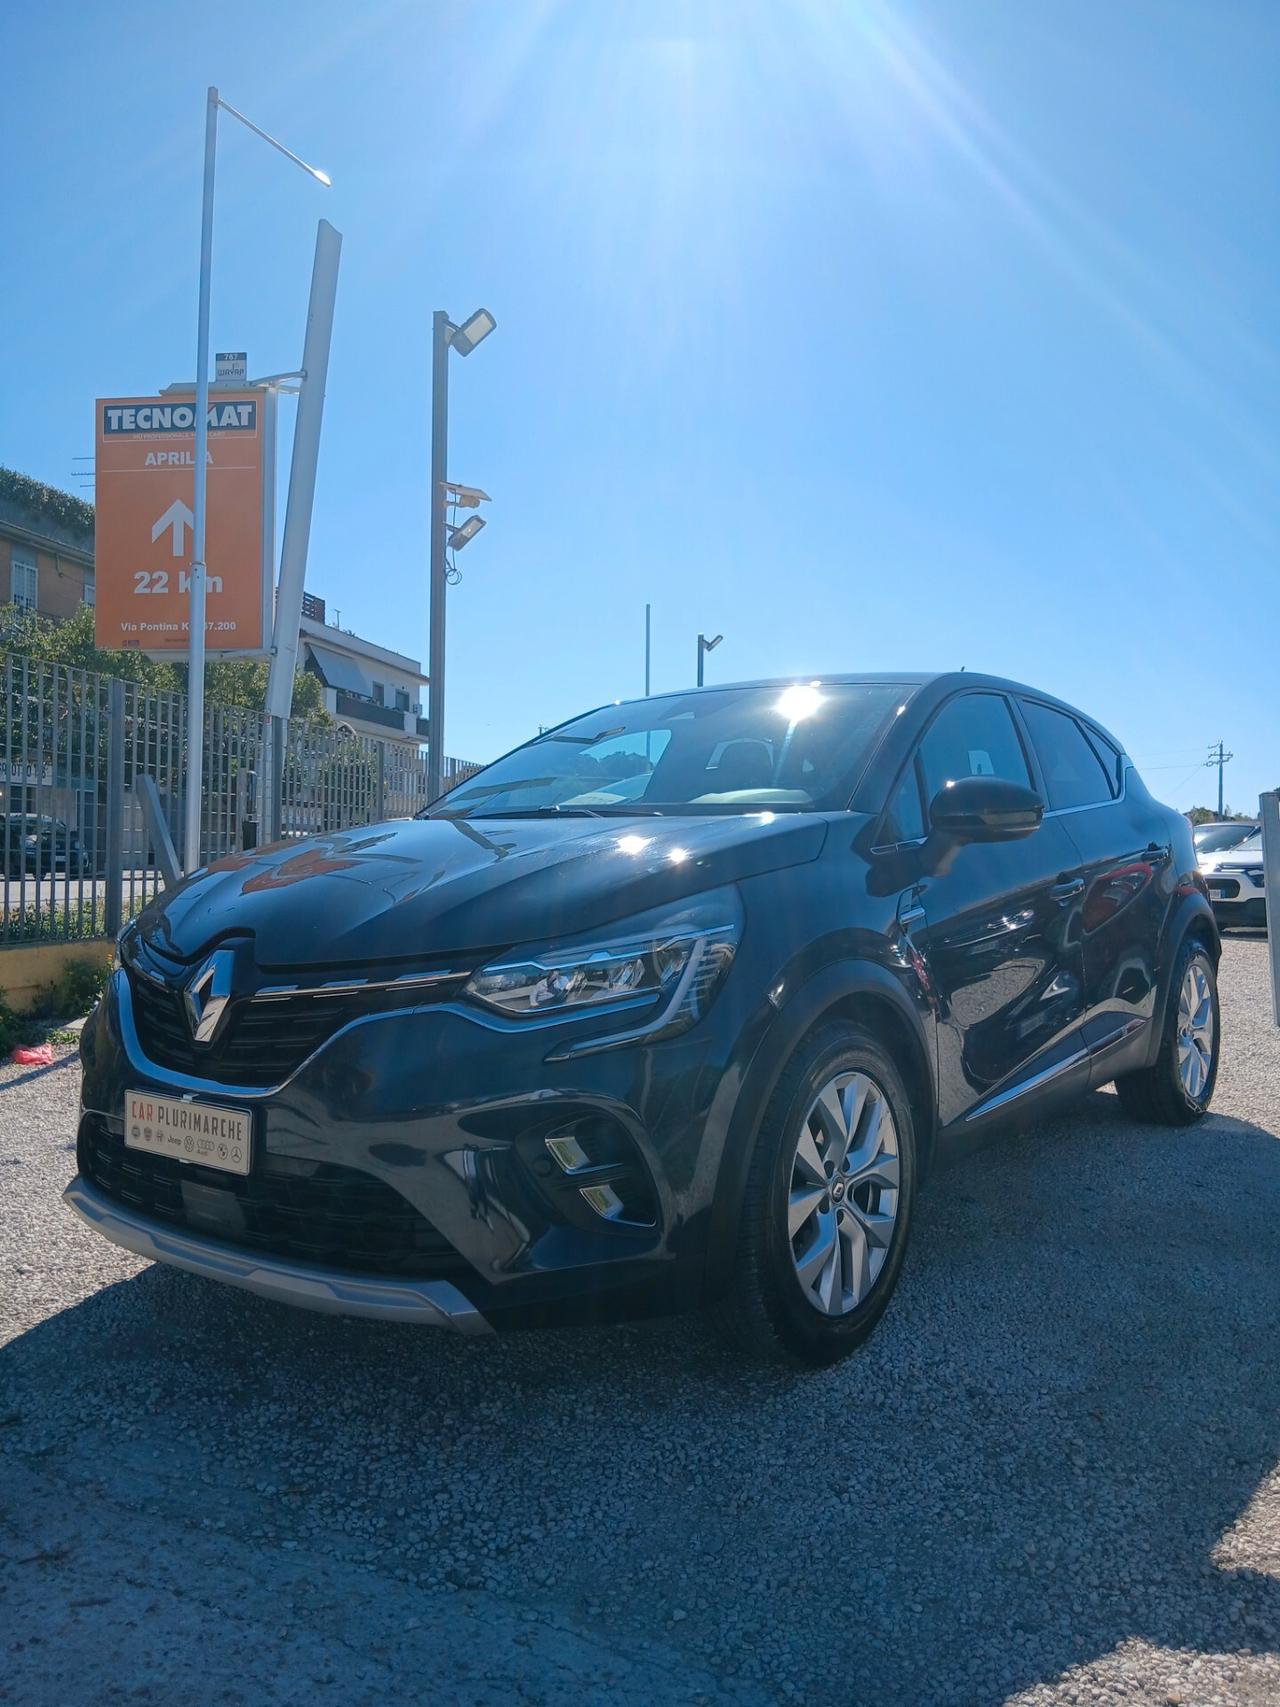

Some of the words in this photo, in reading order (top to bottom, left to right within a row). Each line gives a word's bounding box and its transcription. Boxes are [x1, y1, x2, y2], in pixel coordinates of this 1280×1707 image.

[144, 451, 214, 466] APRILA
[133, 570, 169, 594] 22
[178, 570, 223, 593] km
[120, 622, 137, 631] Via
[140, 622, 179, 631] Pontina
[131, 1100, 153, 1121] CAR
[157, 1105, 242, 1141] PLURIMARCHE
